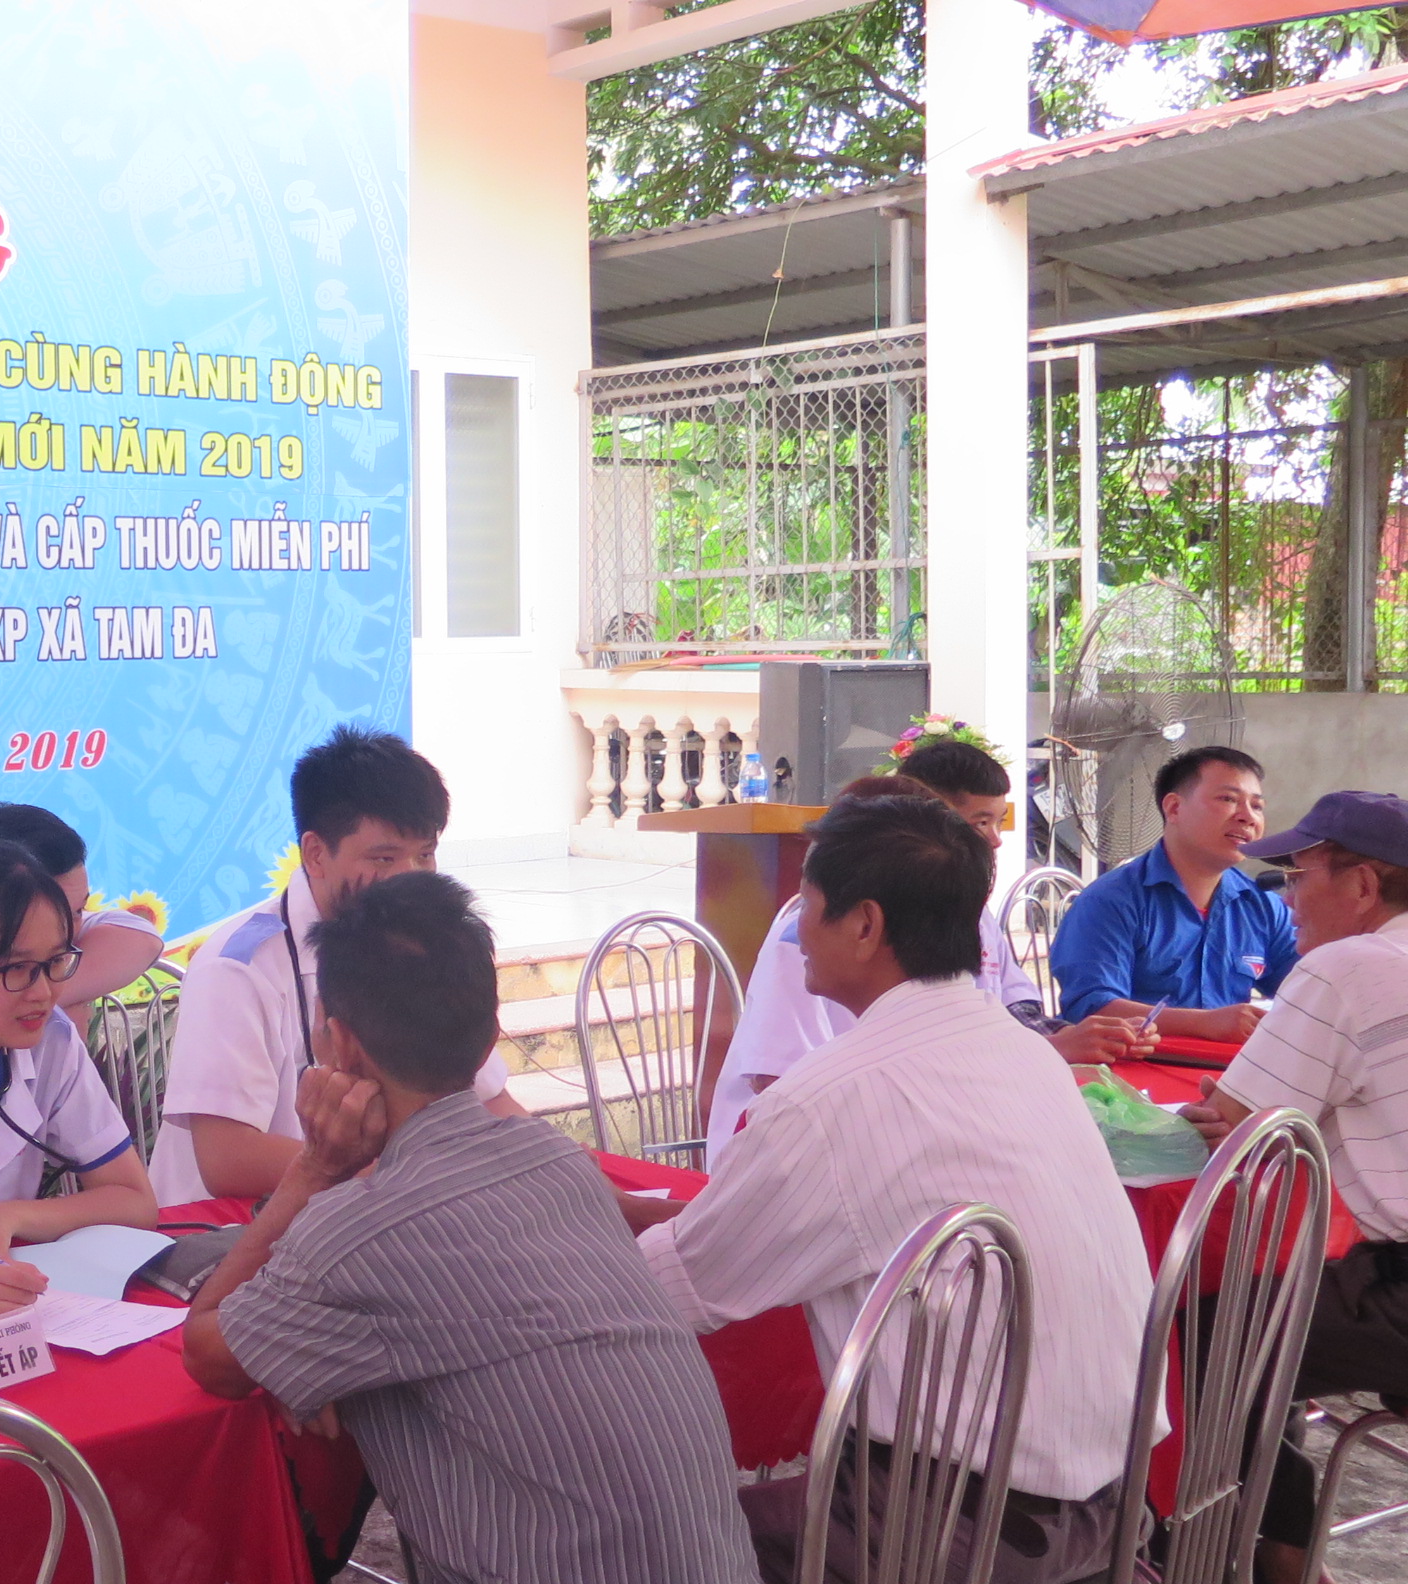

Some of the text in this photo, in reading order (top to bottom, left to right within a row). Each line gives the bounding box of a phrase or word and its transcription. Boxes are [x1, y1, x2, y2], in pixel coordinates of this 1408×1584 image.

[136, 342, 257, 403] HÀNH
[269, 352, 383, 416] ĐỘNG
[80, 417, 186, 476] NĂM
[199, 431, 304, 480] 2019
[35, 496, 107, 570] CẤP
[114, 499, 223, 571] THUỐC
[230, 501, 313, 571] MIỄN
[320, 511, 372, 571] PHÍ
[37, 595, 87, 662] XÃ
[93, 606, 164, 660] TAM
[171, 606, 218, 660] ĐA
[2, 728, 109, 773] 2019
[5, 1321, 32, 1337] PHÒNG
[19, 1344, 38, 1371] ÁP
